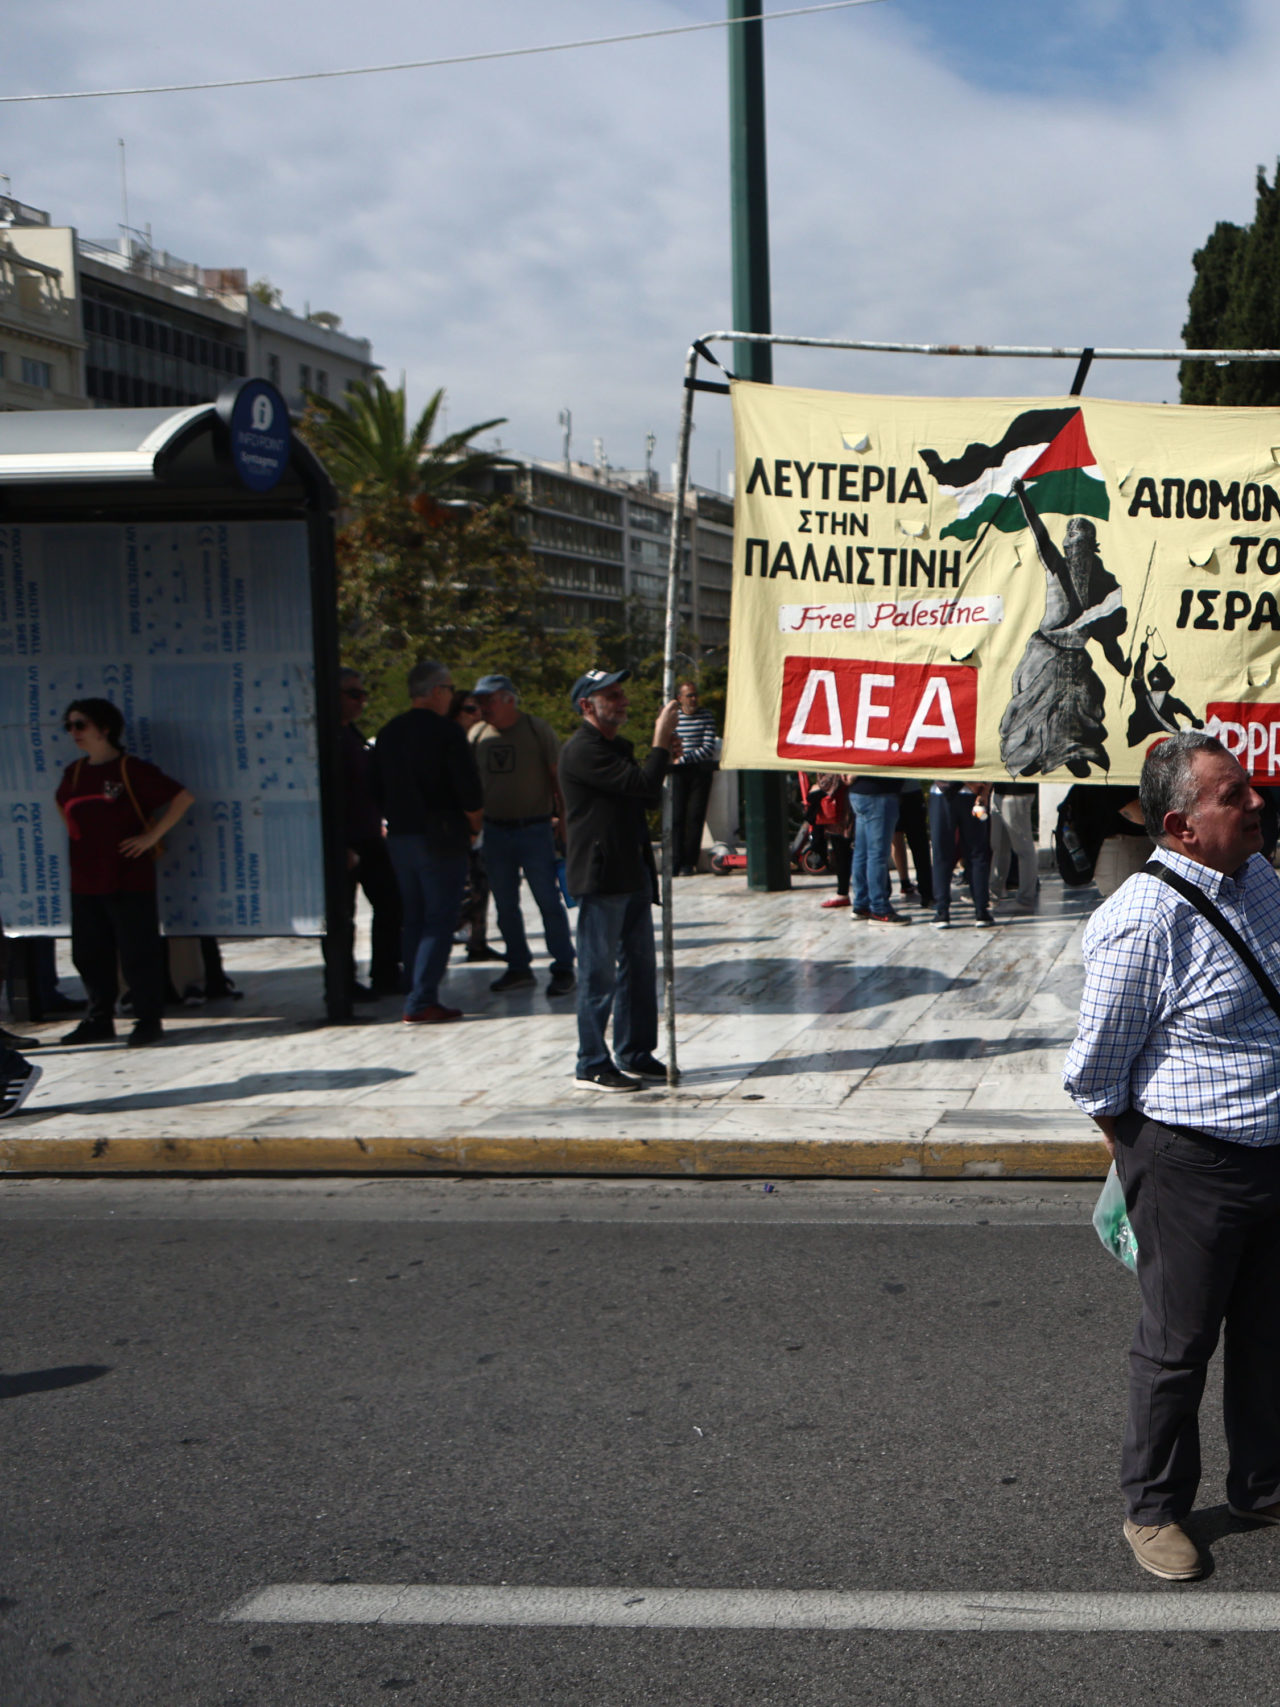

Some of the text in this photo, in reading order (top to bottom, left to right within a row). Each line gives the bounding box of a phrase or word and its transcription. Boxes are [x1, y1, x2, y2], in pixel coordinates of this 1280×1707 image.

[745, 457, 928, 504] ΛΕΥΤΕΡΙΑ
[798, 509, 869, 537] ΣΤΗΝ
[744, 538, 961, 588] ΠΑΛΑΙΣΤΙΝΗ
[790, 600, 989, 630] Free Palestine
[31, 803, 48, 926] POLYCARBONATE SHEET
[49, 854, 61, 926] MULTI-WALL
[232, 801, 248, 926] POLYCARBONATE SHEET
[247, 852, 261, 926] MULTI-WALL
